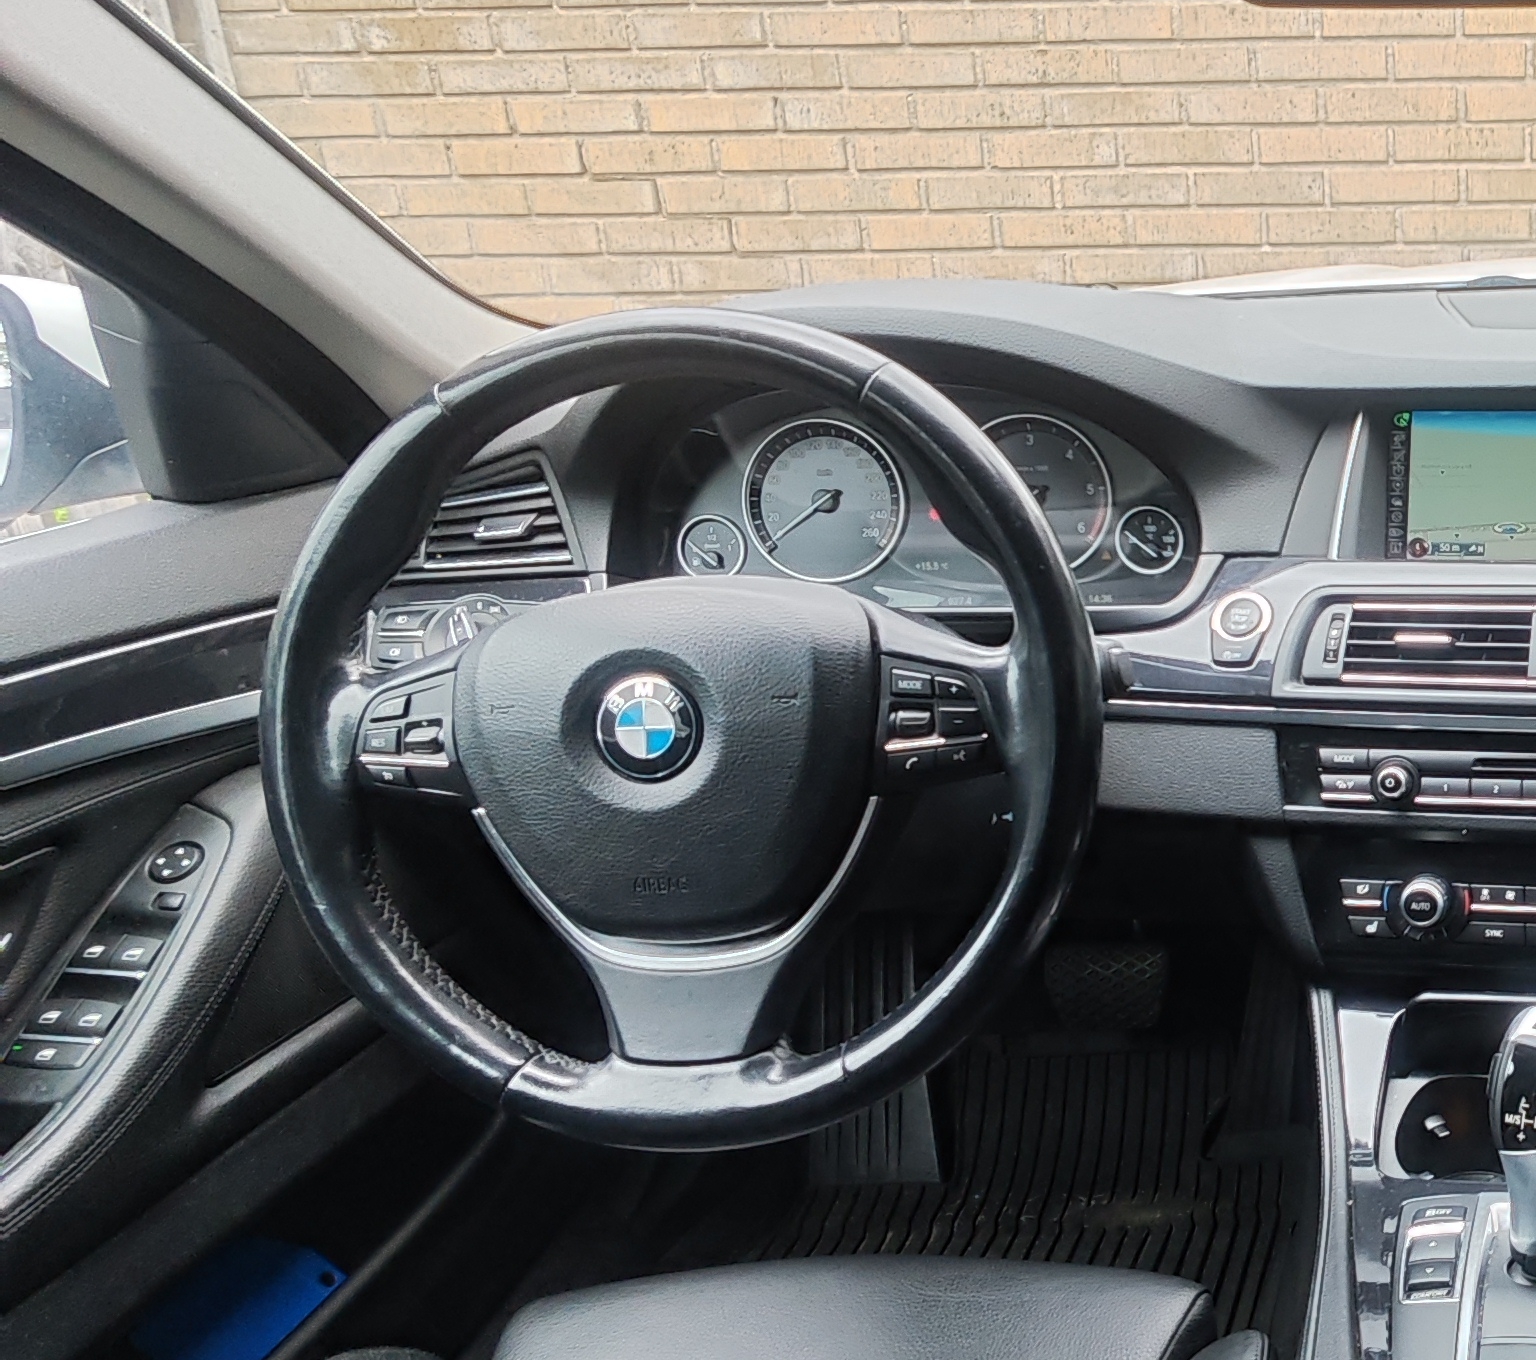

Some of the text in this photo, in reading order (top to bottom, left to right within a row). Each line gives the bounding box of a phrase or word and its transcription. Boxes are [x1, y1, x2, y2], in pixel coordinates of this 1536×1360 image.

[1025, 434, 1034, 446] 3
[1065, 449, 1074, 460] 4
[1086, 483, 1095, 495] 5
[768, 512, 780, 522] 20
[870, 510, 888, 520] 240
[861, 527, 880, 538] 260
[1077, 522, 1086, 534] 6
[1440, 542, 1450, 551] 50
[897, 680, 923, 690] MODE
[607, 681, 685, 715] BMW
[1442, 783, 1448, 792] 1
[1493, 785, 1500, 794] 2
[633, 876, 689, 893] AIRBAG
[1410, 901, 1431, 911] AUTO
[1484, 929, 1504, 939] SYNC
[1504, 1113, 1521, 1124] M/S
